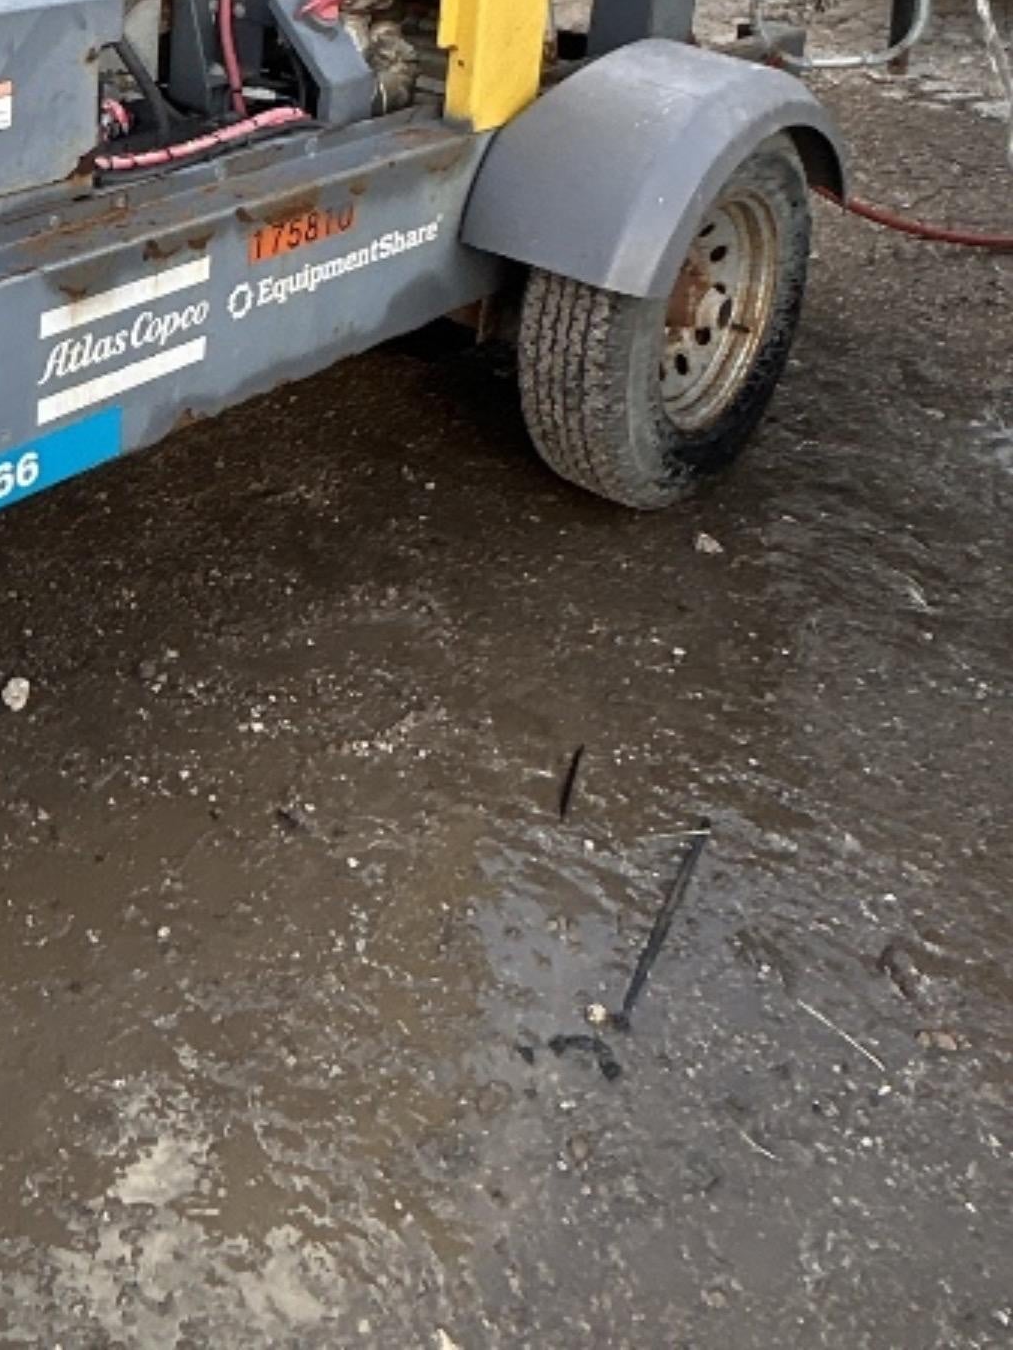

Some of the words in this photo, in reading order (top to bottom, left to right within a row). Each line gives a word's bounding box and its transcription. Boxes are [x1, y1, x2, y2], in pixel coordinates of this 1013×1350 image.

[255, 219, 439, 307] EquipmentShare
[37, 329, 129, 385] Atlas
[131, 299, 210, 348] Copco
